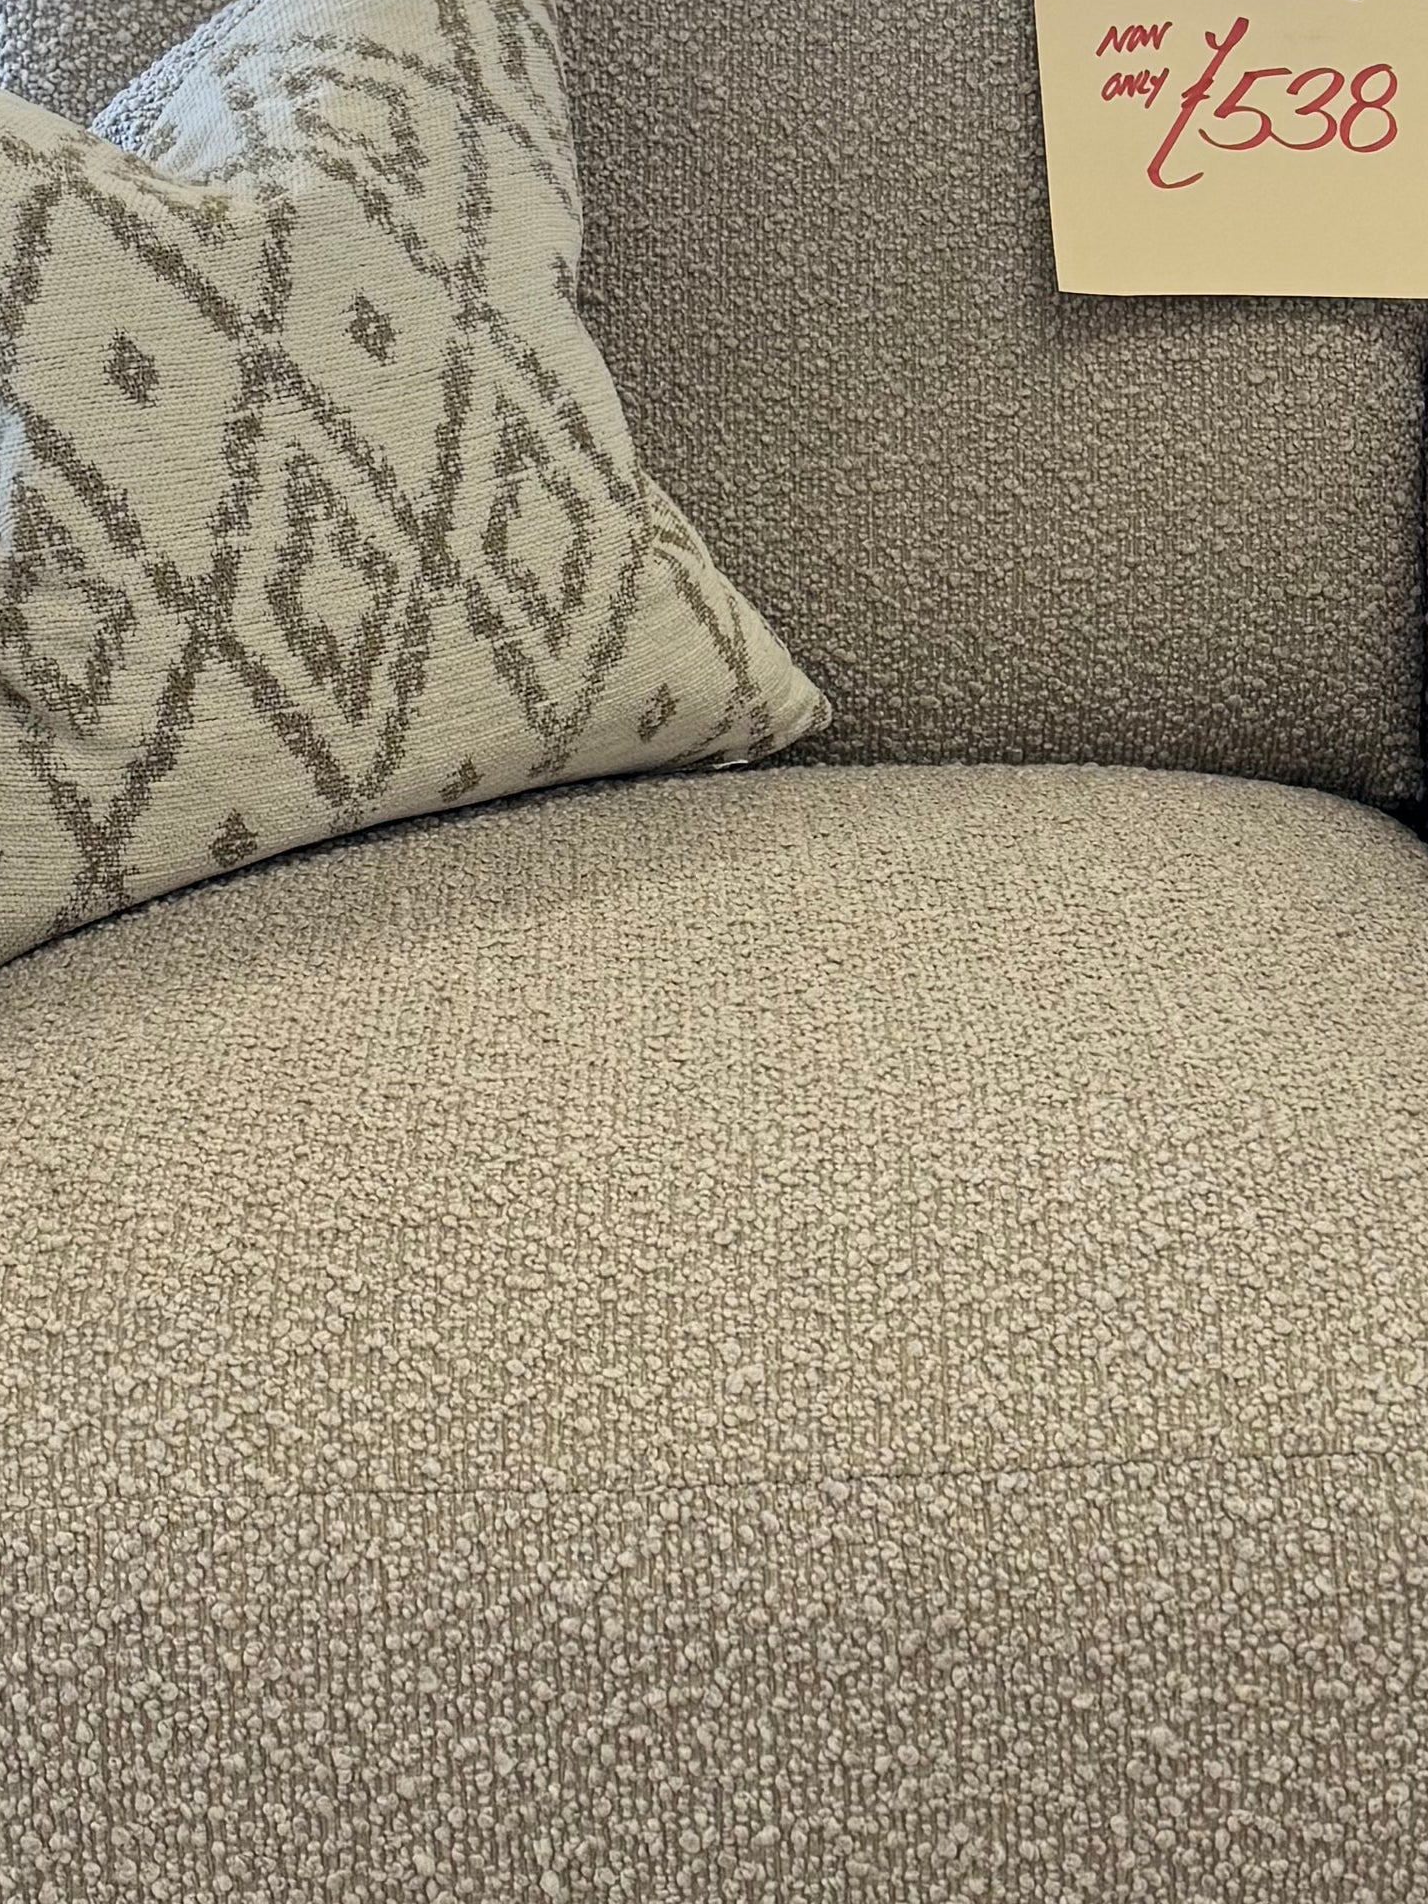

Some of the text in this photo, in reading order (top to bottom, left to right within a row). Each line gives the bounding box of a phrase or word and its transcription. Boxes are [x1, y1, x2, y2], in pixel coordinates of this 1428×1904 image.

[1095, 21, 1174, 59] NOW
[1101, 67, 1171, 110] ONLY
[1146, 16, 1399, 190] £538
